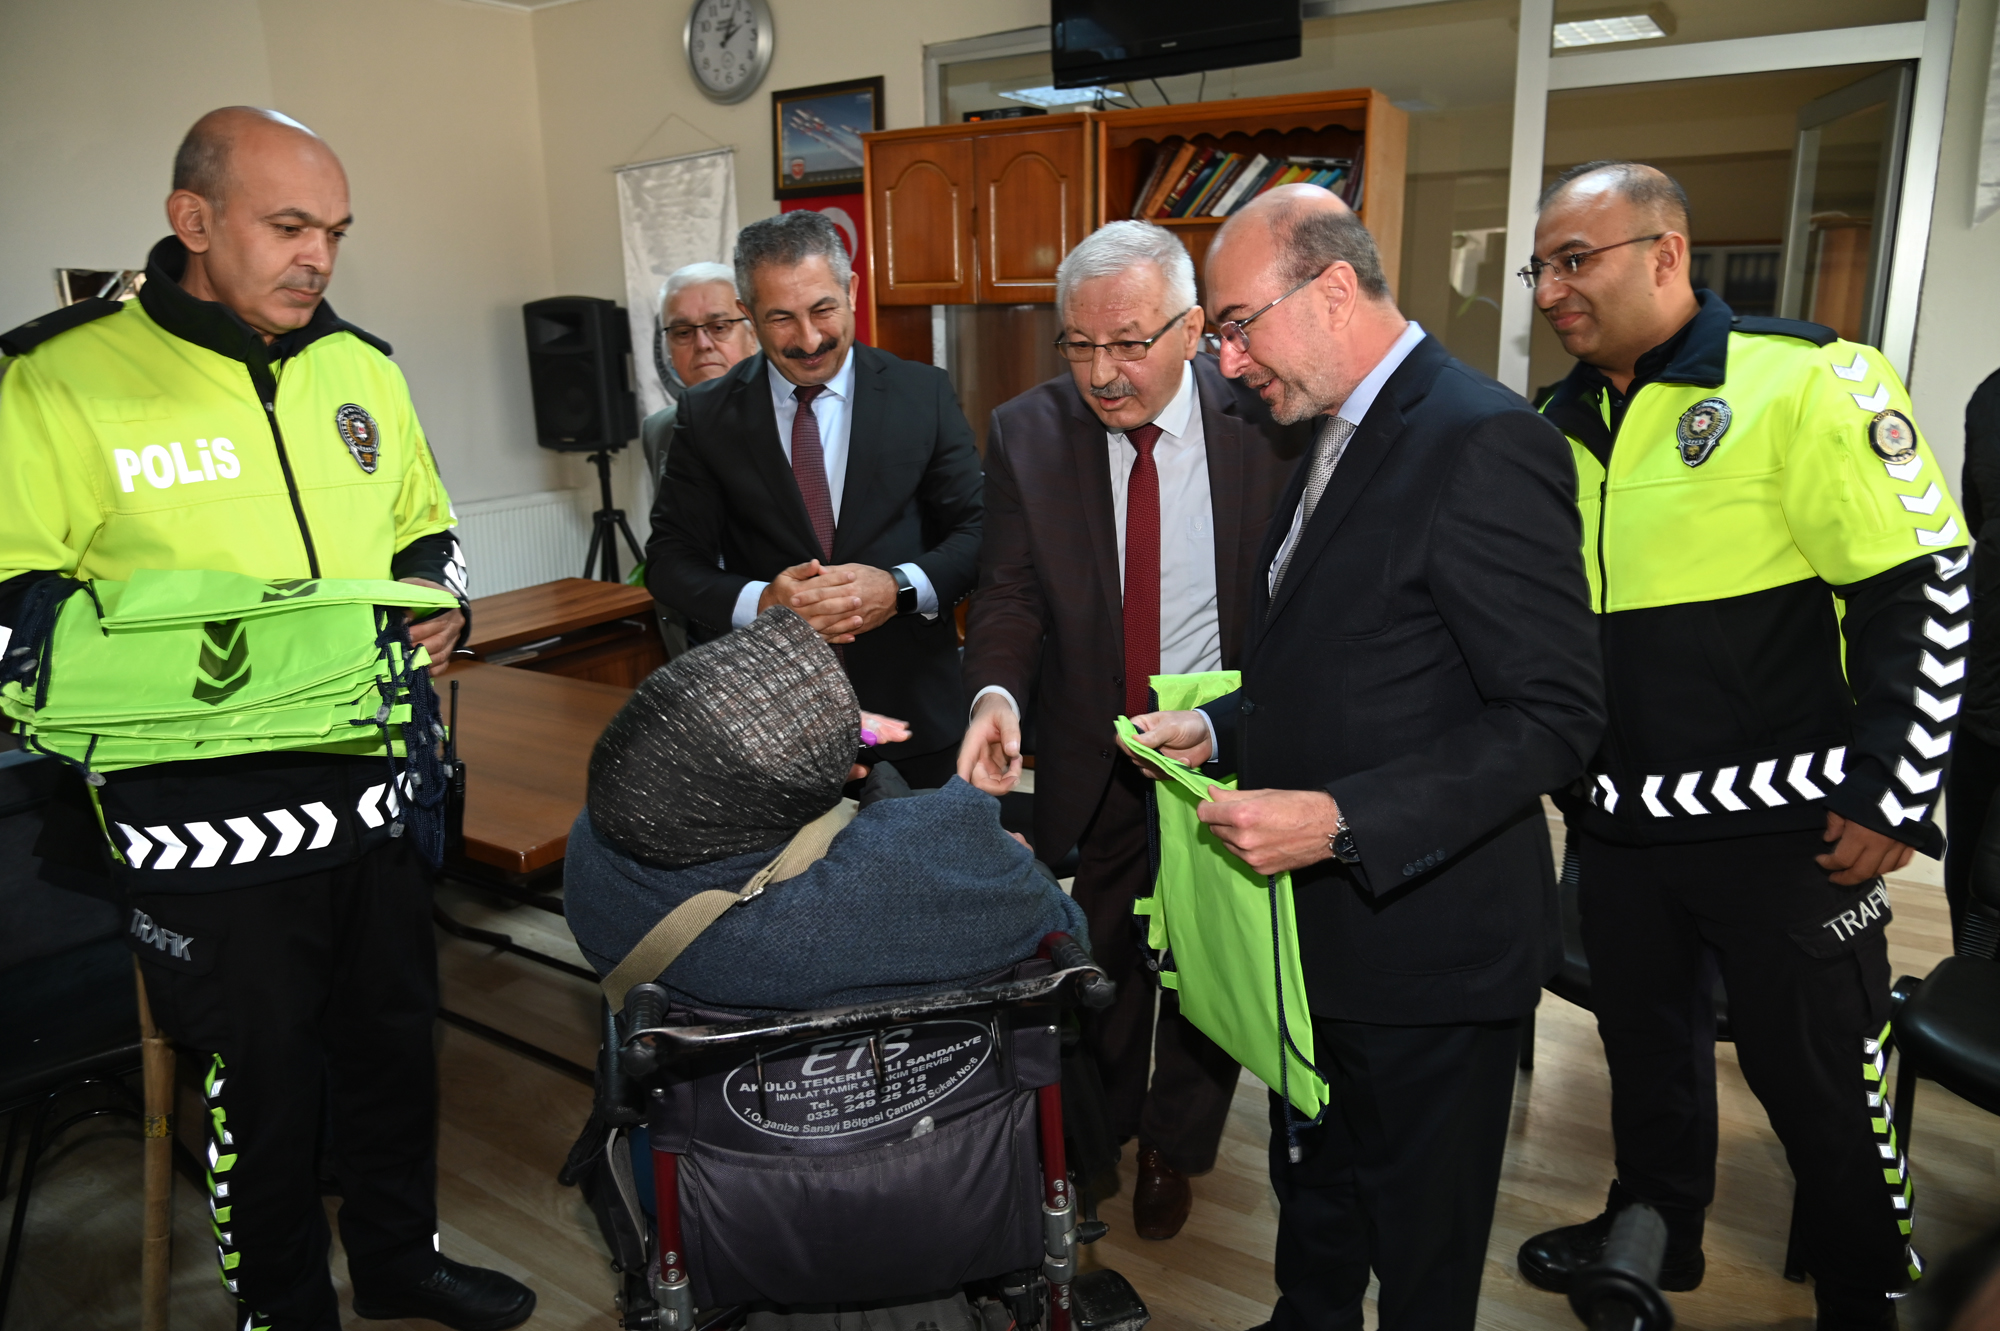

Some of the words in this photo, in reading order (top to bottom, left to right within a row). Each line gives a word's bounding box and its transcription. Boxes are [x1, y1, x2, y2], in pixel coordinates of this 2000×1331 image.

[906, 1035, 982, 1067] SANDALYE
[806, 1107, 839, 1122] 0332
[843, 1098, 877, 1114] 249
[880, 1091, 902, 1104] 25
[906, 1083, 927, 1095] 42
[843, 1089, 877, 1105] 248
[907, 1073, 928, 1086] 18
